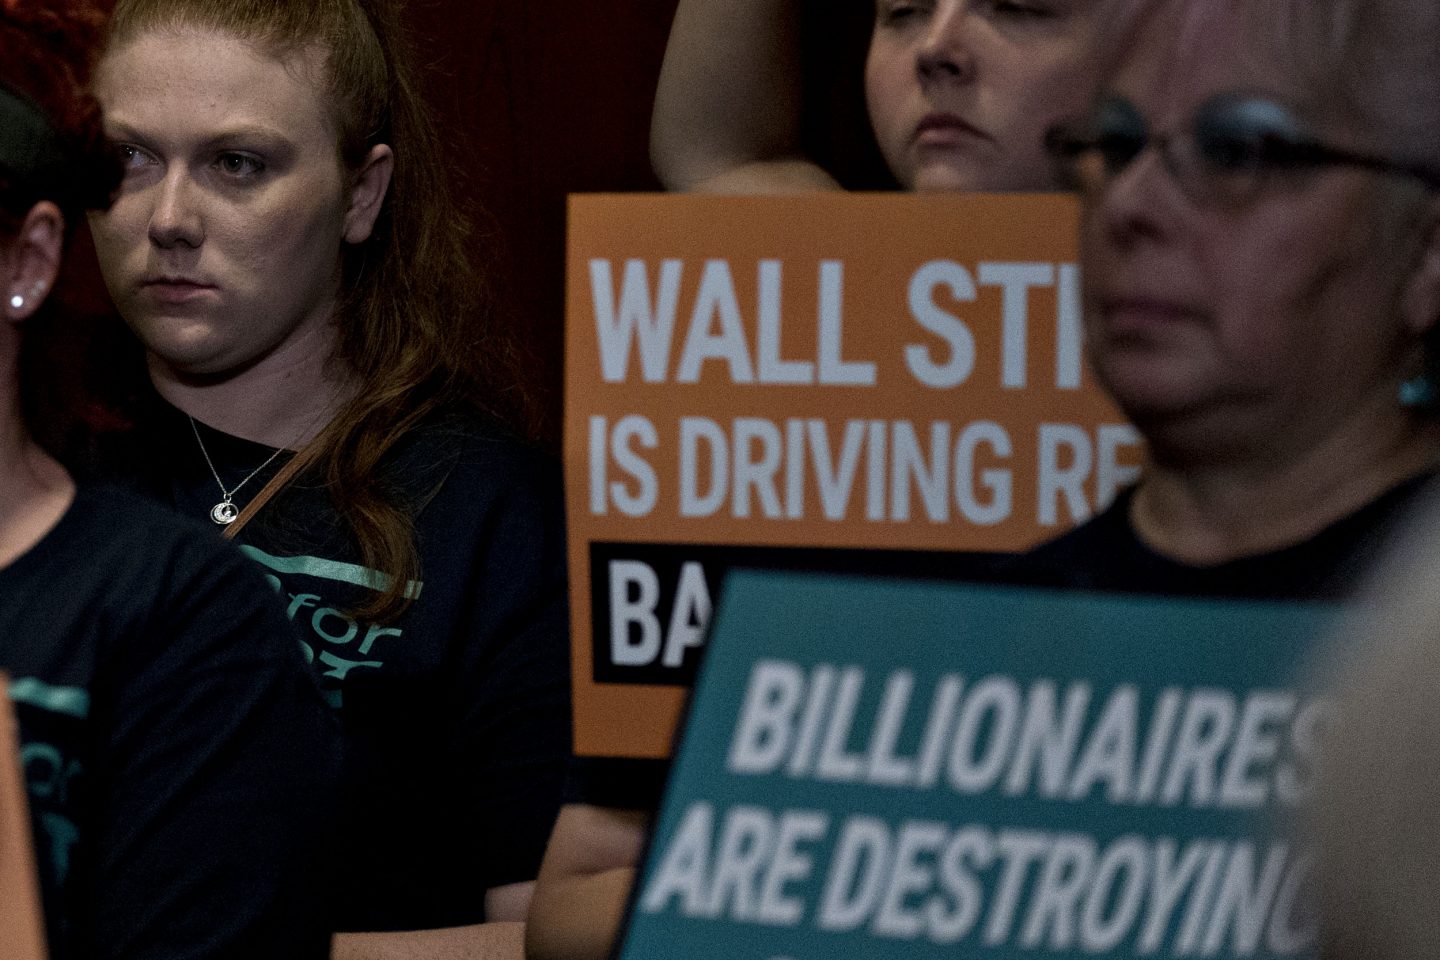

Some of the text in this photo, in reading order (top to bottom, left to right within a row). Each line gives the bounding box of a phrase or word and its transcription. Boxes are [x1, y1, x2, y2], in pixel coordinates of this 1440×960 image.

[589, 258, 877, 385] WALL
[589, 415, 659, 517] IS
[679, 416, 1012, 525] DRIVING
[643, 800, 830, 927] ARE
